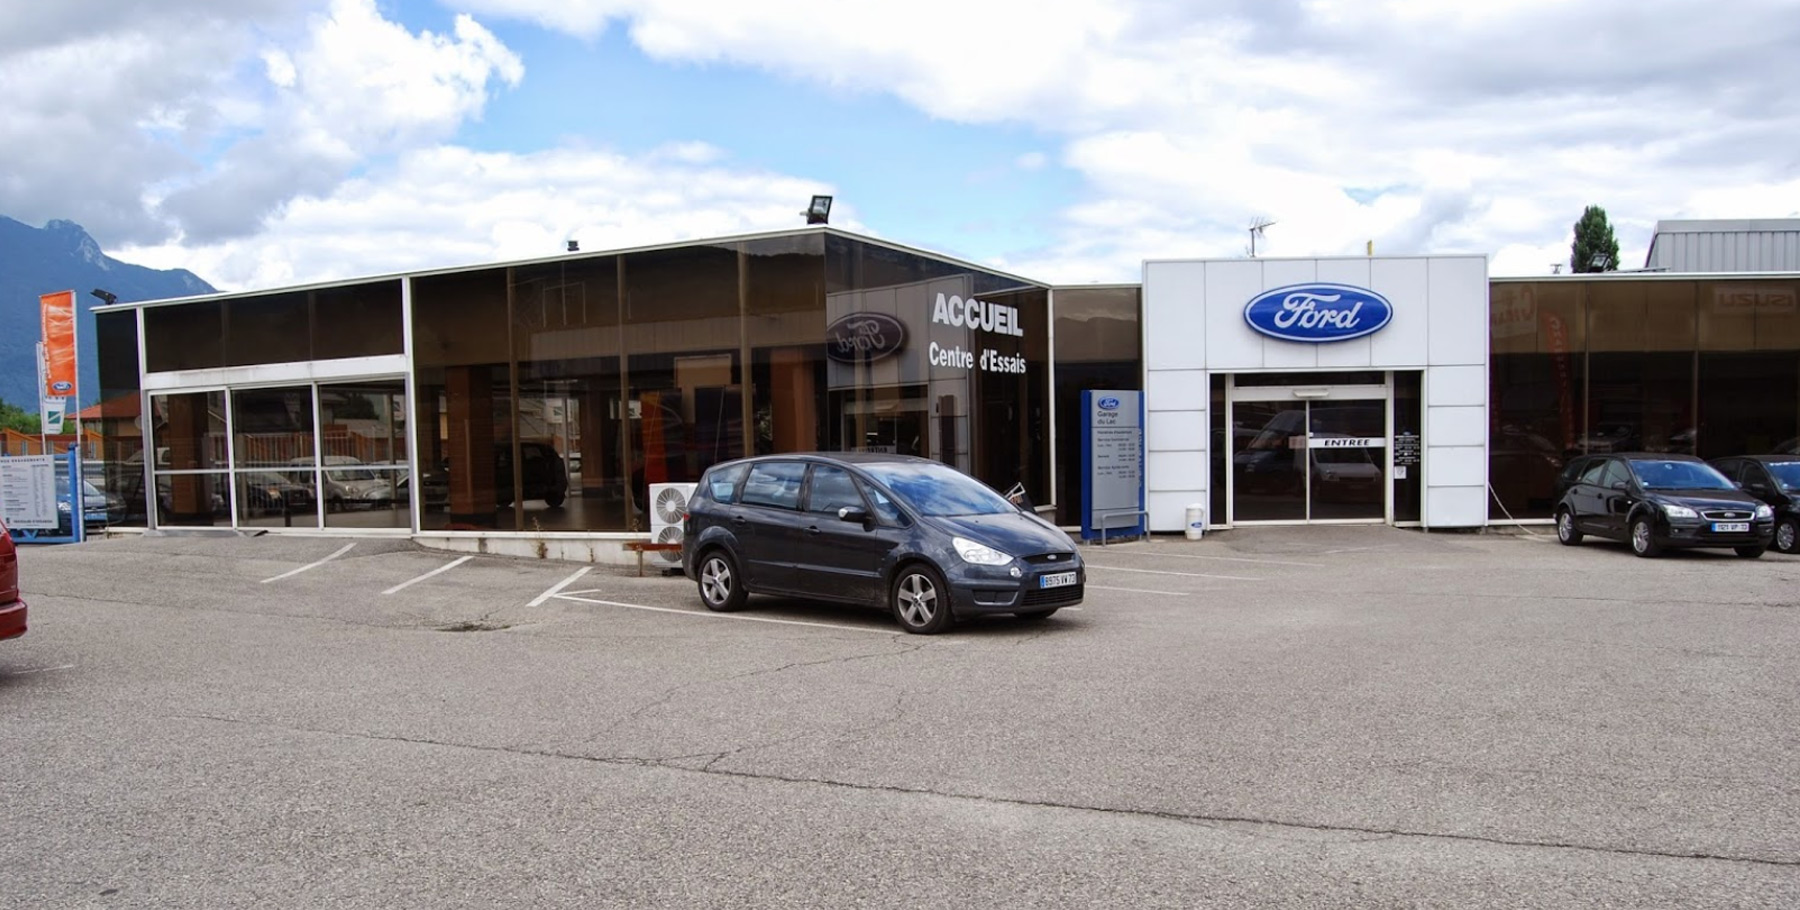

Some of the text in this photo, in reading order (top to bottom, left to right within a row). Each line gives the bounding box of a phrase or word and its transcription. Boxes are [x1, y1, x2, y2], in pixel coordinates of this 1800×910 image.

[932, 292, 1024, 337] ACCUEIL
[1274, 292, 1363, 328] Ford
[929, 341, 1026, 374] Centre d'Essais
[1097, 410, 1118, 419] Garage
[1324, 438, 1370, 447] ENTREE
